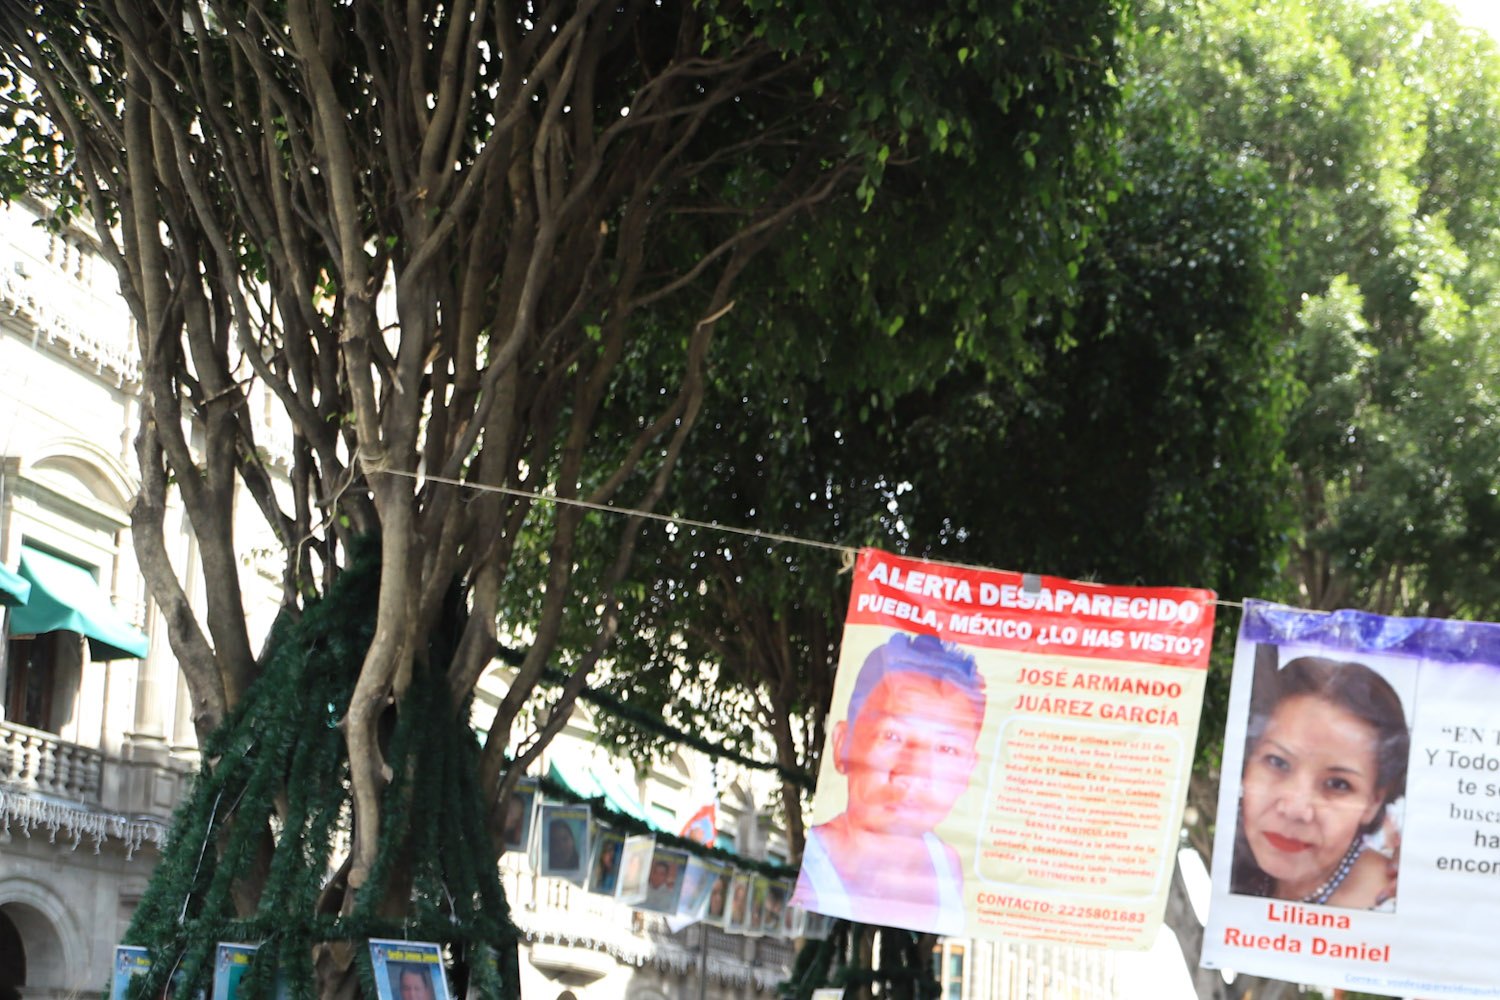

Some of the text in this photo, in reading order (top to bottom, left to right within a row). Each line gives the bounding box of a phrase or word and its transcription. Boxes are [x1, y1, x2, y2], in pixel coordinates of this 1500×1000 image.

[868, 562, 1199, 624] ALERTA DESAPARECIDO
[857, 594, 1205, 656] PUEBLA, MÉXICO ¿LO HAS VISTO?
[1016, 667, 1181, 698] JOSÉ ARMANDO
[1014, 693, 1179, 726] JUÁREZ GARCÍA
[1425, 748, 1440, 766] Y
[1458, 777, 1477, 795] te
[977, 892, 1146, 923] CONTACTO: 2225801683
[1267, 902, 1350, 929] Liliana
[1224, 927, 1390, 962] Rueda Daniel
